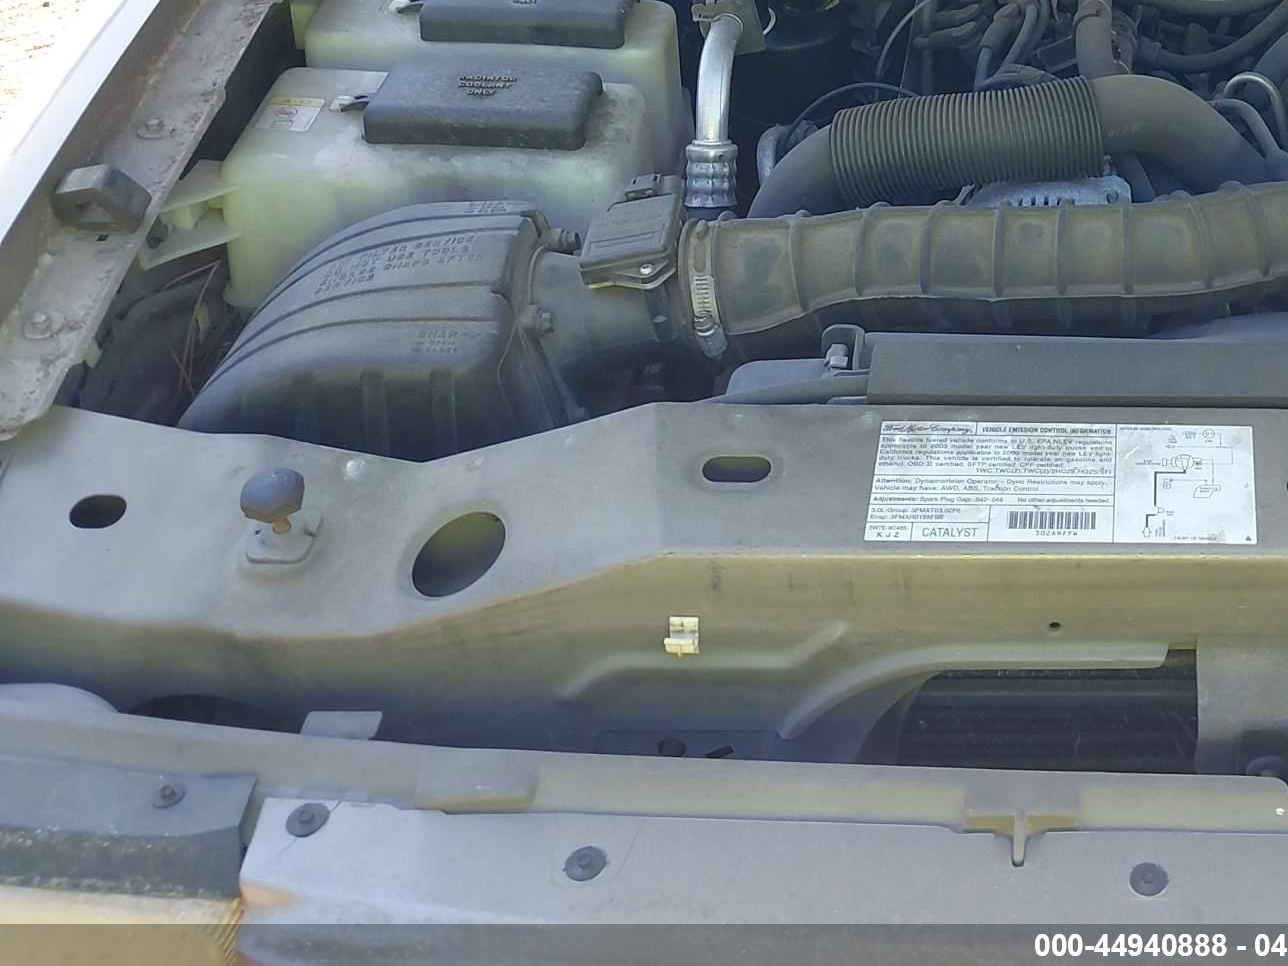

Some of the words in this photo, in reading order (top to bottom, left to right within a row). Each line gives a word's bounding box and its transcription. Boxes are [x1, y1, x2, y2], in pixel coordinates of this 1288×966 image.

[458, 74, 518, 83] RADIATOR
[457, 81, 513, 89] COOLANT
[465, 88, 497, 96] ONLY
[921, 527, 979, 538] CATALYST
